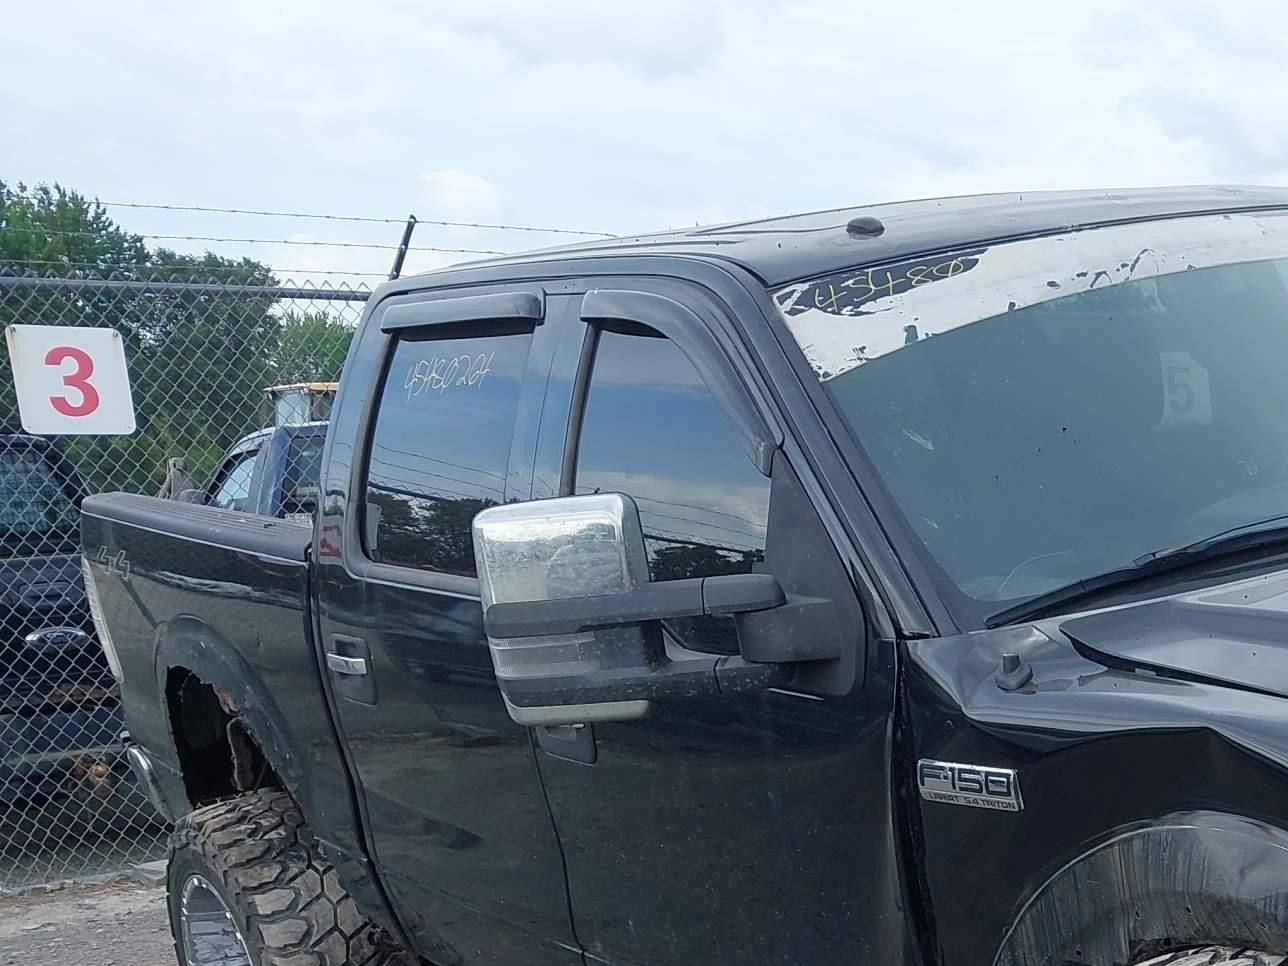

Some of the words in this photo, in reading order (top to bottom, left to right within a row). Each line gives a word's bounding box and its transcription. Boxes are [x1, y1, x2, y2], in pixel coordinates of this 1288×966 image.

[44, 345, 100, 418] 3
[1166, 365, 1195, 414] 5
[928, 791, 960, 803] LARIAT
[981, 799, 1016, 809] TRITON
